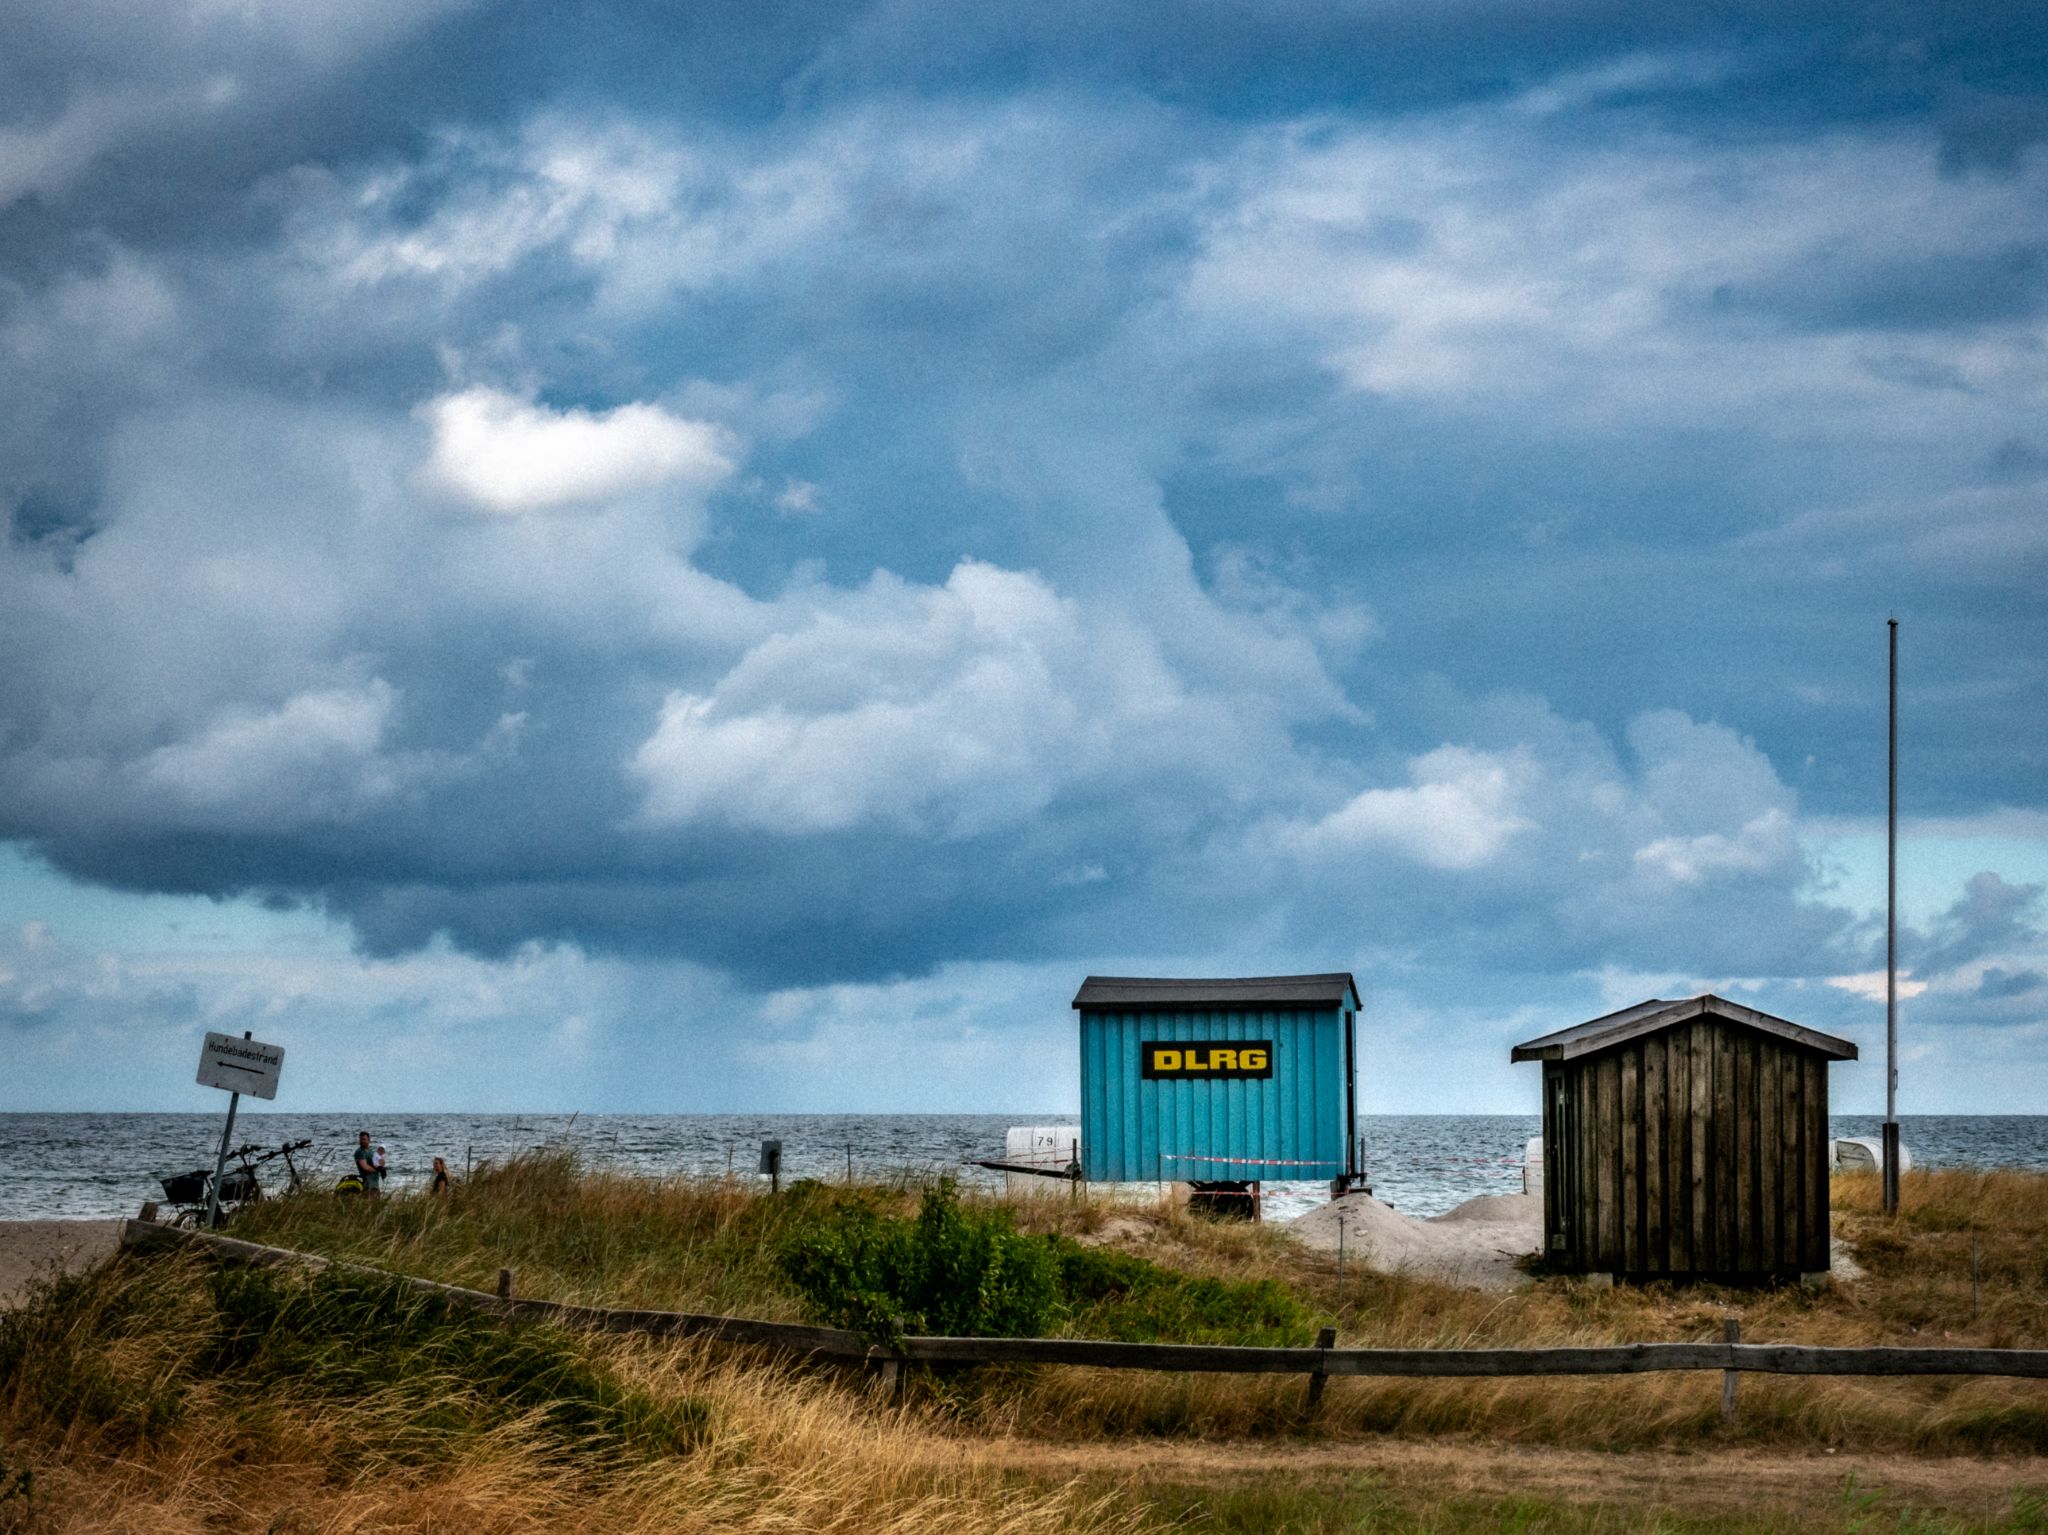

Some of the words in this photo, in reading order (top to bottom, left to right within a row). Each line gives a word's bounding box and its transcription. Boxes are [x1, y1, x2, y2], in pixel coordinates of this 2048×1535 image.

[208, 1041, 278, 1066] Hundebadestrand
[1154, 1049, 1267, 1071] DLRG
[1037, 1136, 1053, 1147] 79
